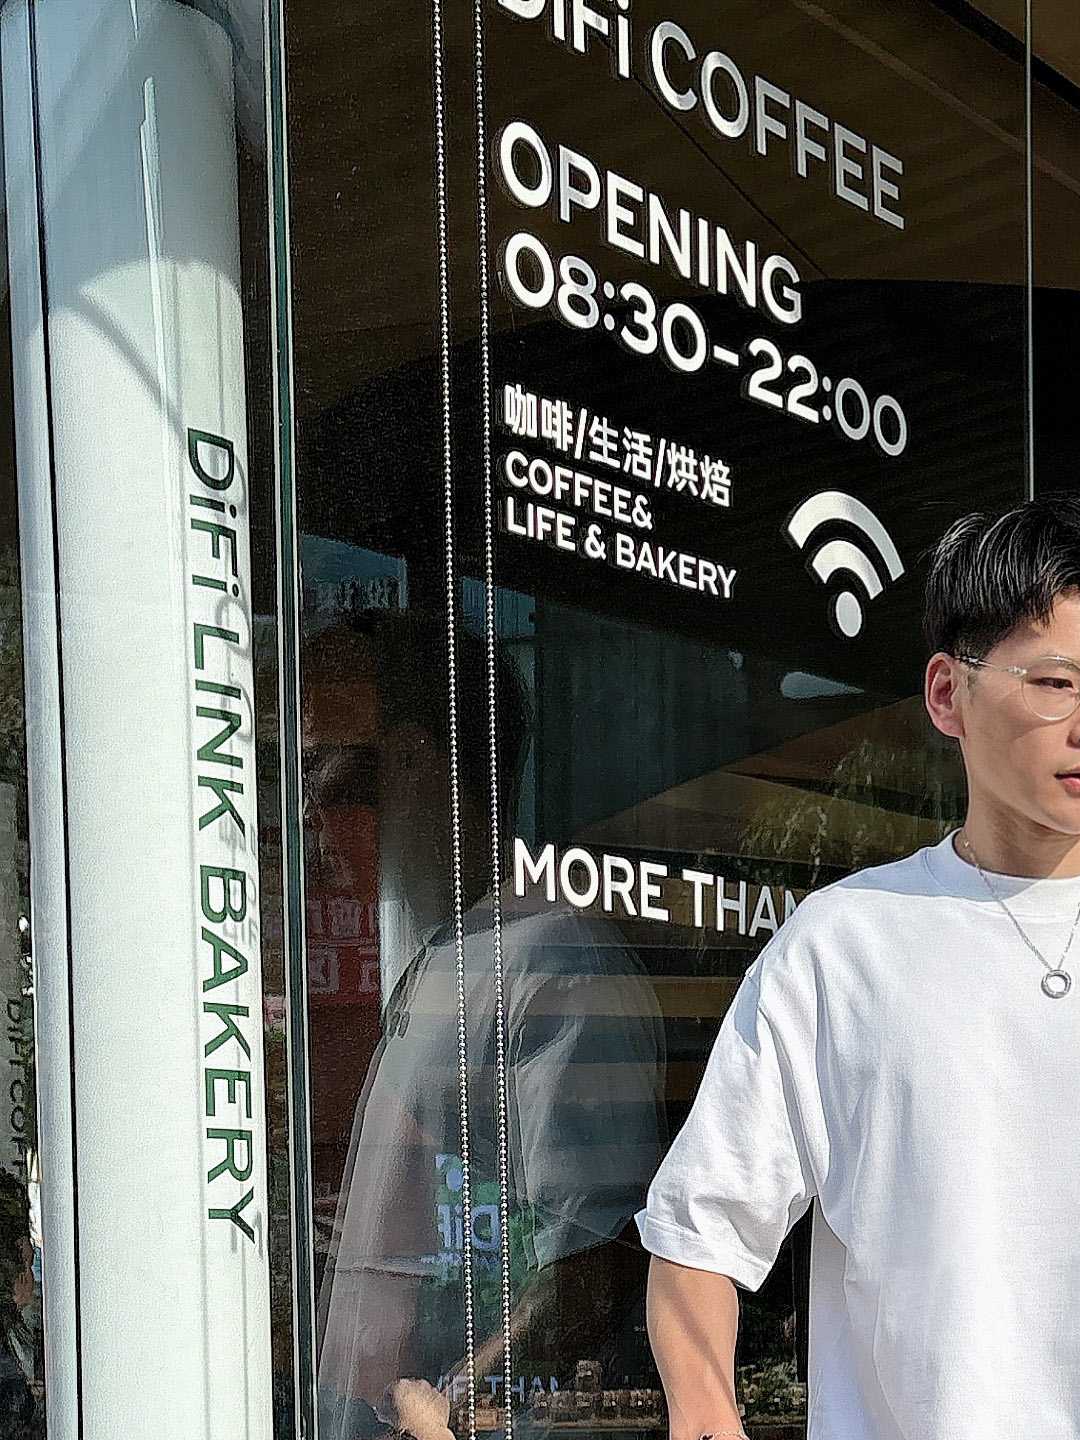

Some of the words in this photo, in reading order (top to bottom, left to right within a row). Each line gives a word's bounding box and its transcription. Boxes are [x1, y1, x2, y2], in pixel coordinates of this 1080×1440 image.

[497, 0, 632, 79] Fi
[651, 20, 905, 231] COFFEE
[500, 121, 802, 324] OPENING
[503, 231, 908, 457] 08:30-22:00
[187, 427, 240, 598] DiFi
[505, 450, 654, 531] COFFEE&
[505, 496, 577, 552] LIFE
[583, 523, 608, 561] &
[616, 532, 738, 599] BAKERY
[193, 622, 246, 839] LINK
[514, 837, 669, 922] MORE
[199, 863, 256, 1245] BAKERY
